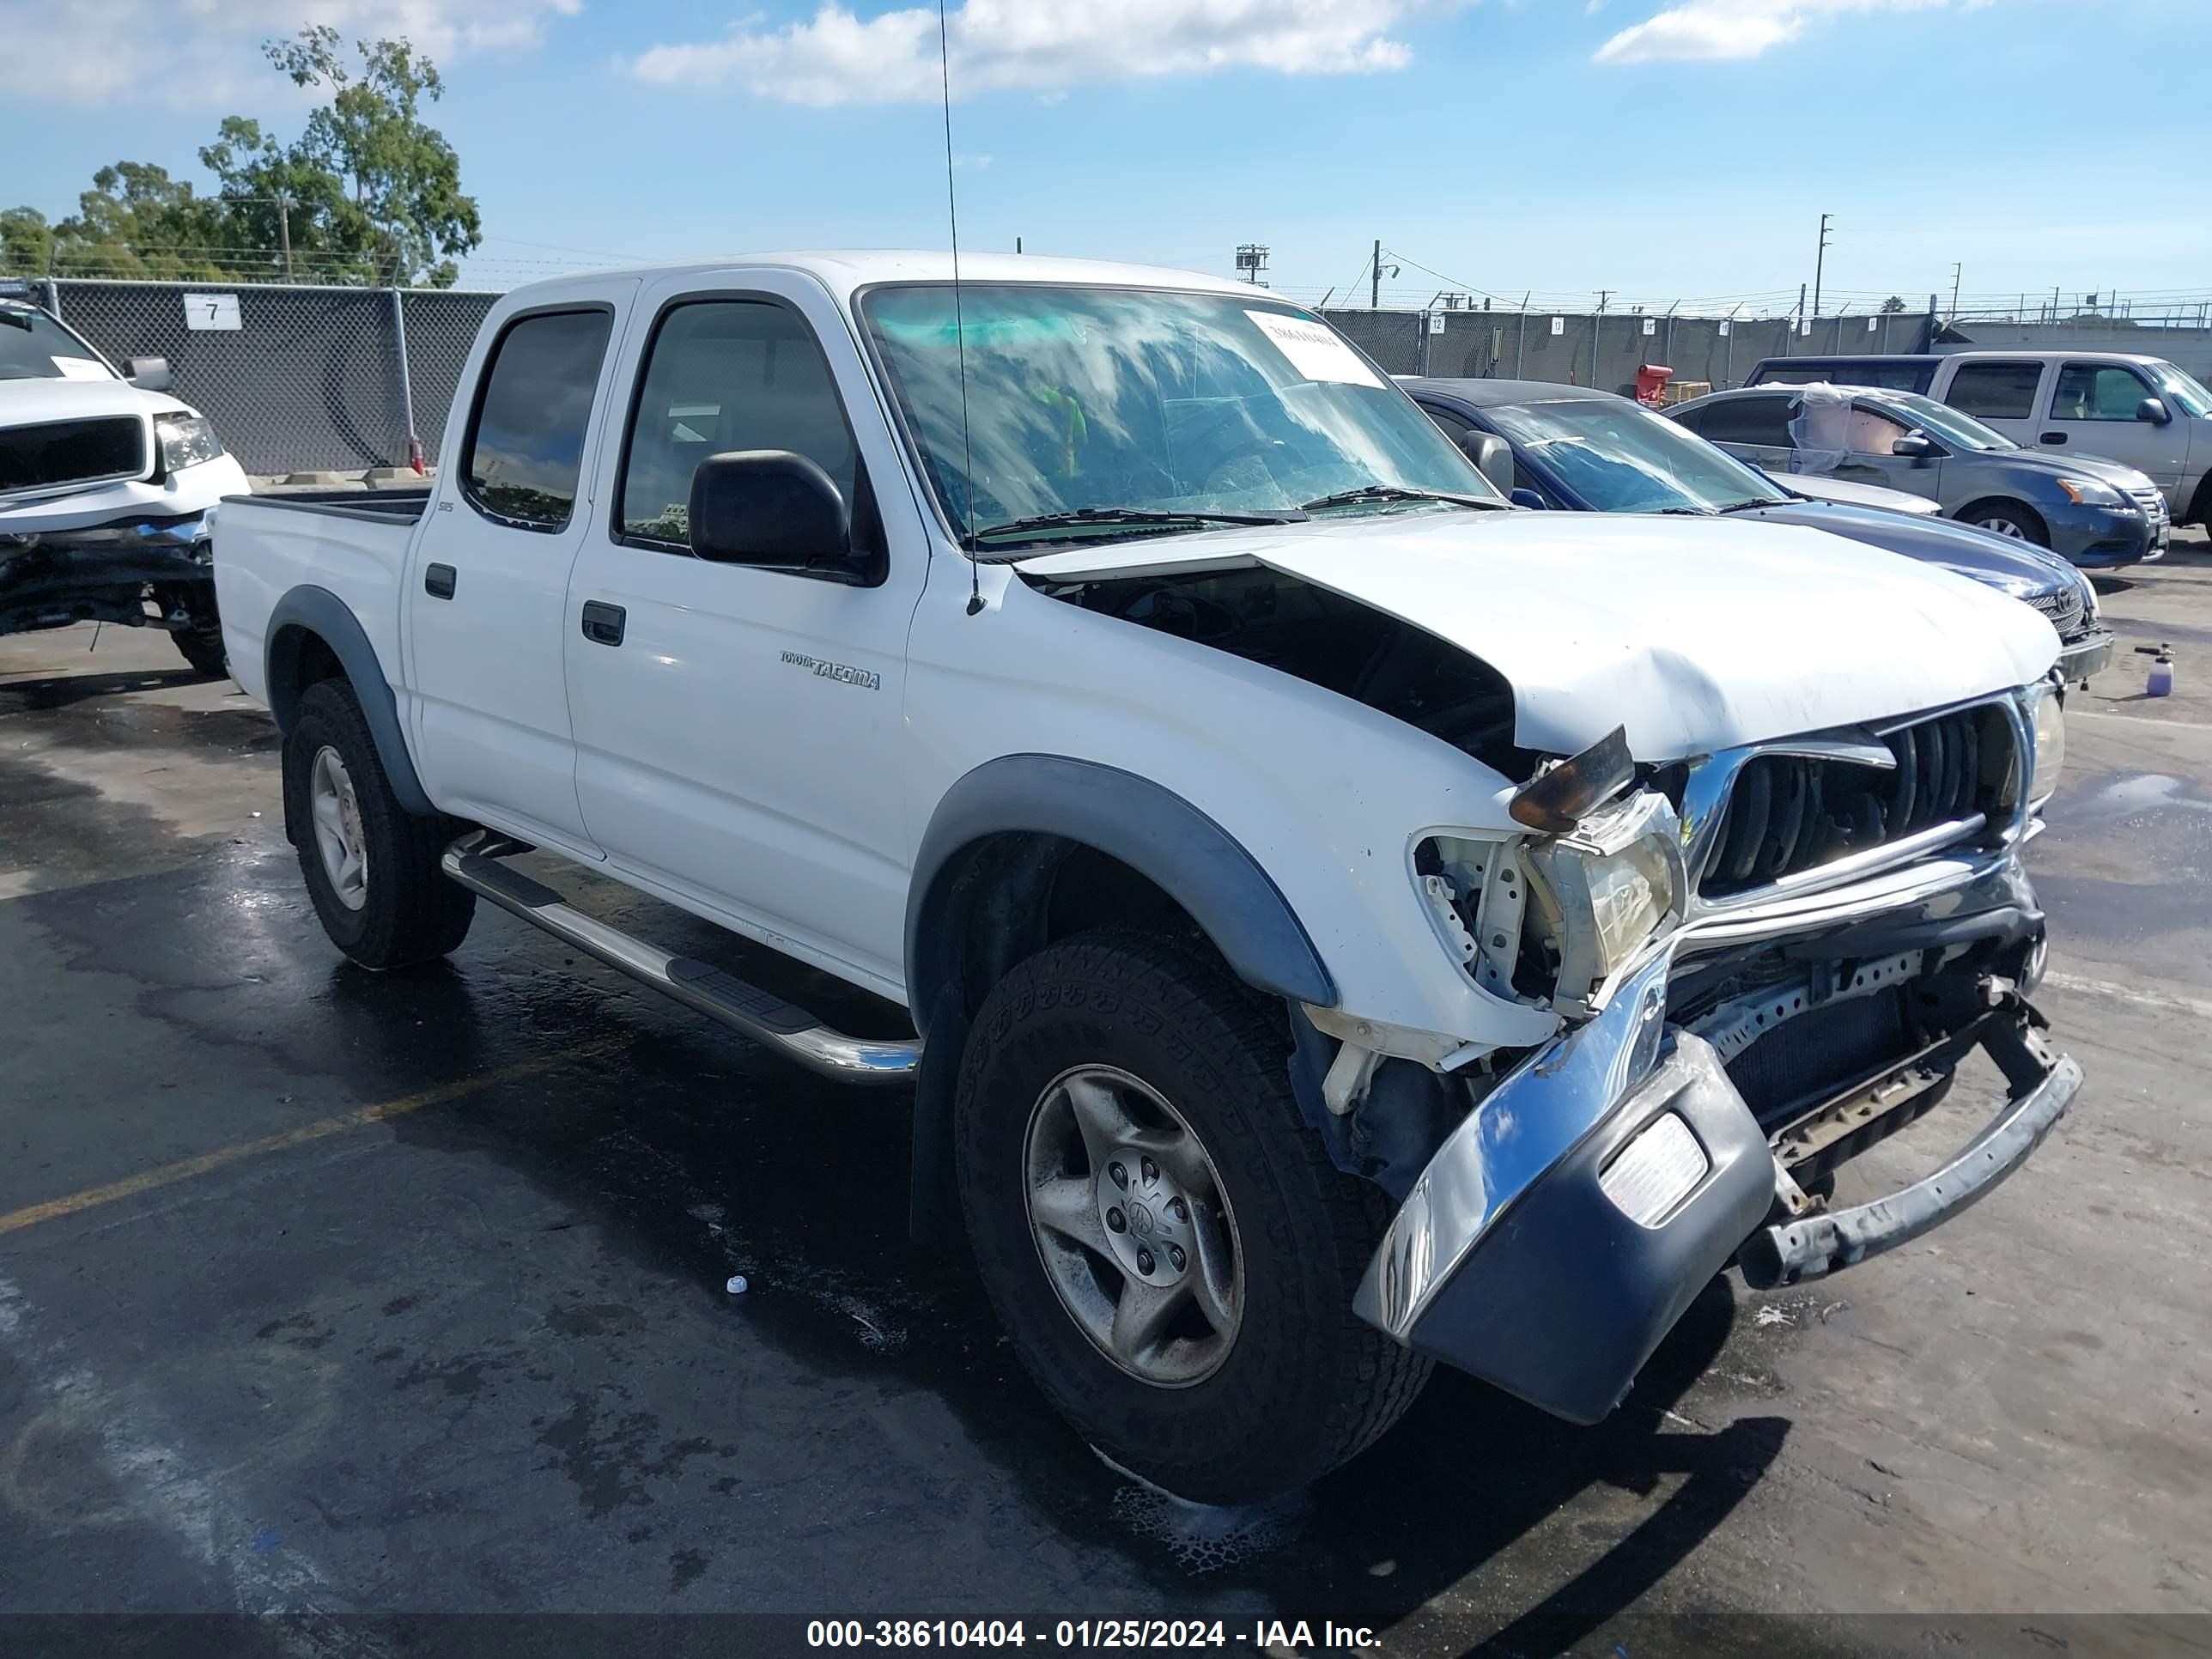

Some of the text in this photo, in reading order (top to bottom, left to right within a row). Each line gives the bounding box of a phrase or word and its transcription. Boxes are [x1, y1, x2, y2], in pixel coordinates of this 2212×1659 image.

[206, 303, 218, 320] 7
[1433, 319, 1441, 330] 12
[1554, 321, 1561, 331] 13
[1645, 322, 1653, 332] 14
[780, 650, 880, 691] TOYOTA TACOMA
